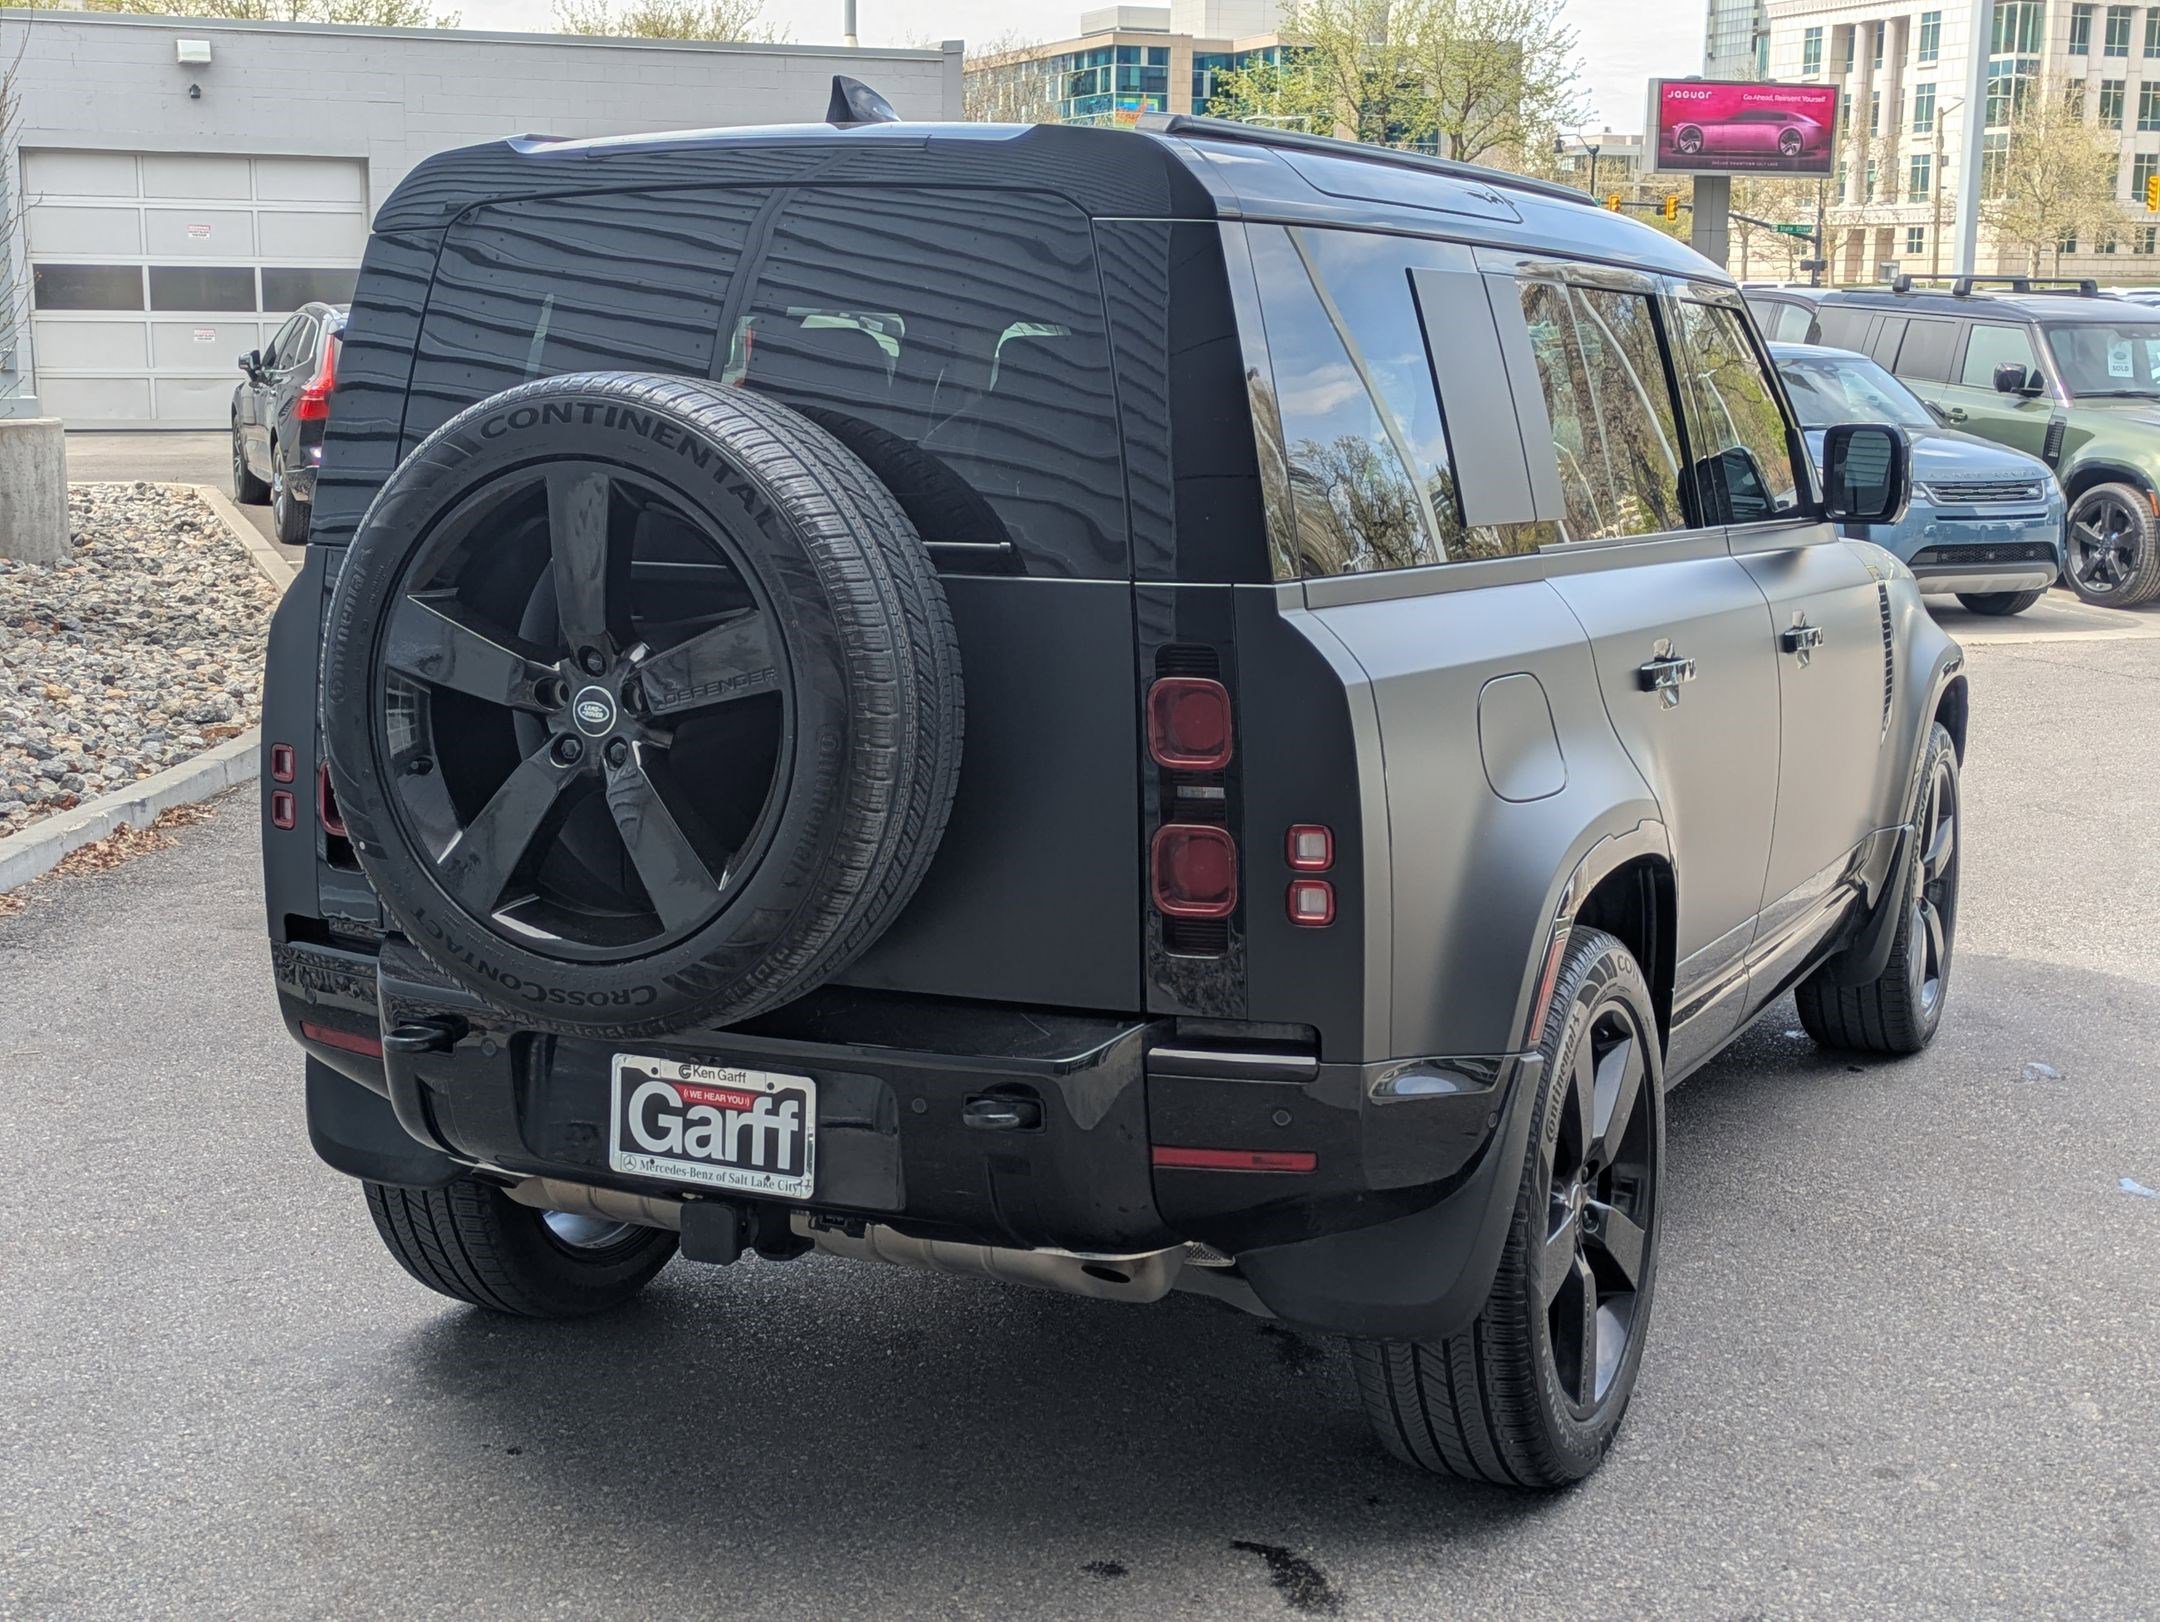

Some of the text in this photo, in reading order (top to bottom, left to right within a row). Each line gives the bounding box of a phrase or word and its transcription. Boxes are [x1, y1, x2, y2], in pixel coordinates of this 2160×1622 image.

[1743, 93, 1753, 101] Go
[480, 402, 778, 540] CONTINENTAL
[663, 665, 777, 704] DEFENDER
[692, 1063, 747, 1084] Ken Garff
[1545, 1027, 1577, 1144] Continental
[689, 1090, 744, 1105] WE HEAR YOU
[628, 1081, 800, 1170] Garff
[639, 1159, 800, 1197] Mercedes-Benz of Salt Lake City
